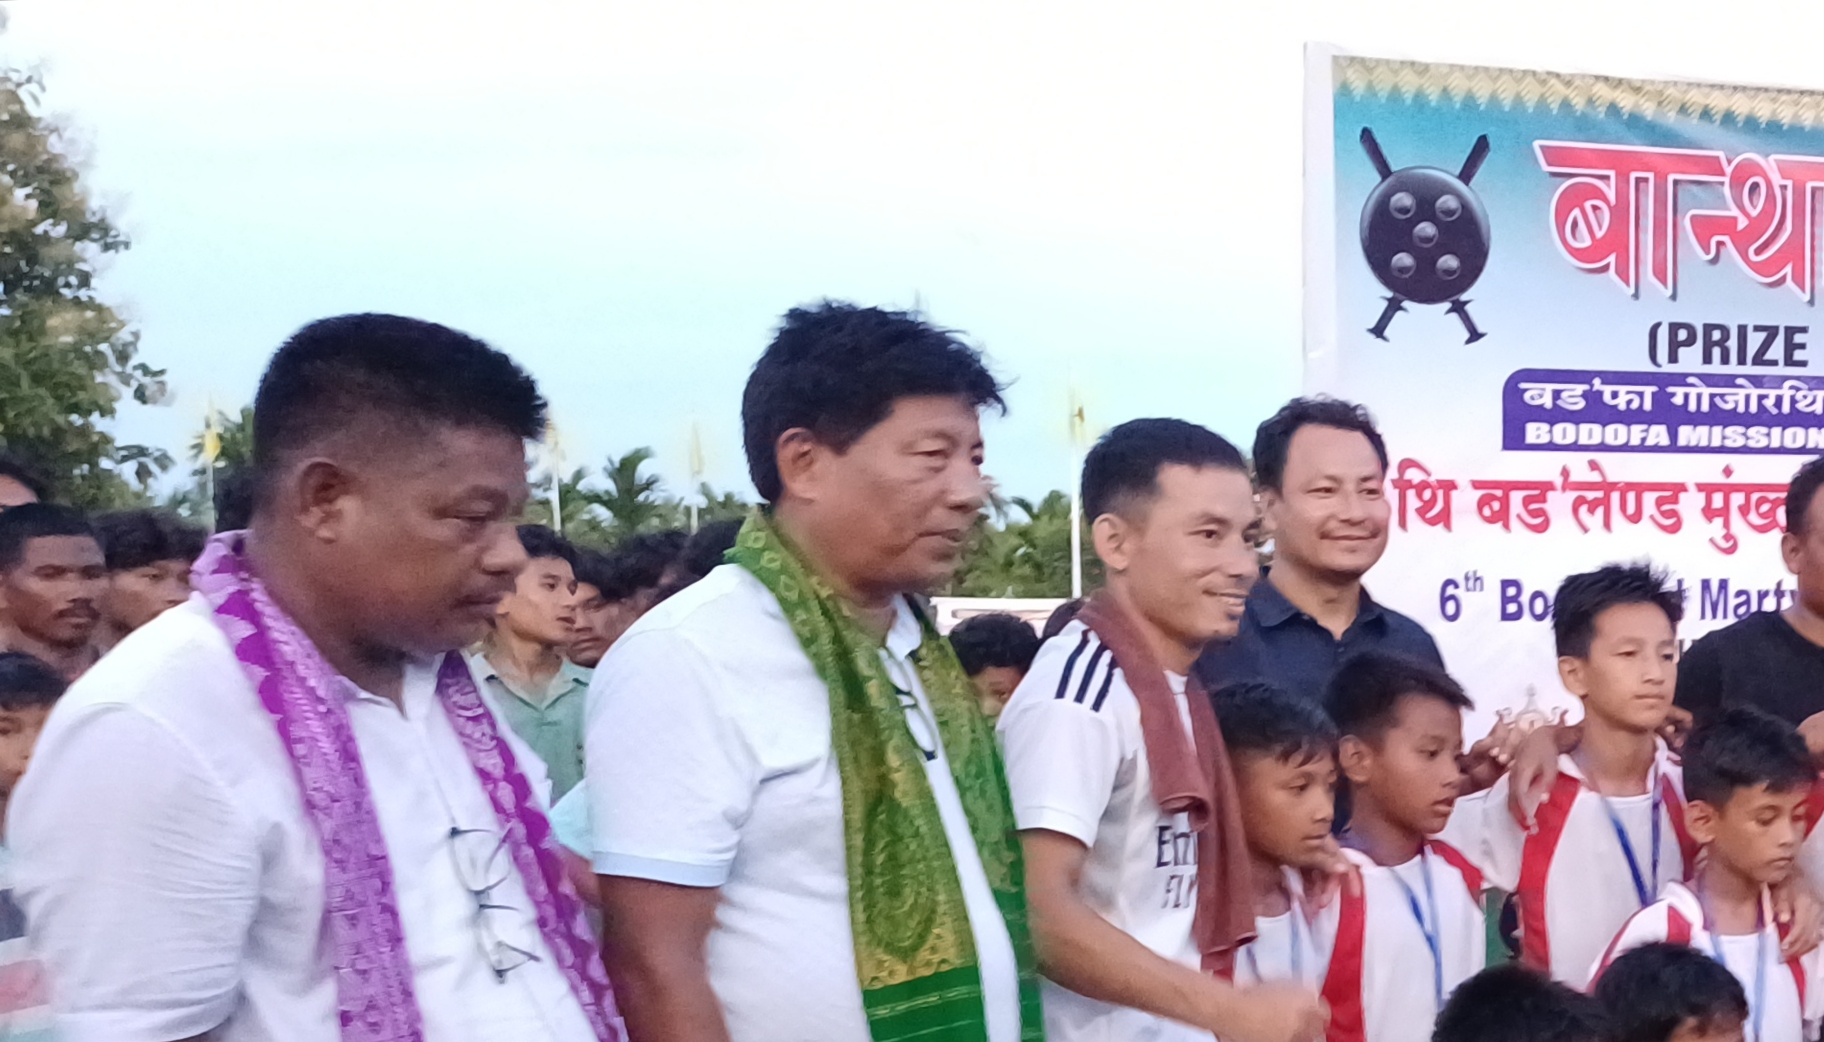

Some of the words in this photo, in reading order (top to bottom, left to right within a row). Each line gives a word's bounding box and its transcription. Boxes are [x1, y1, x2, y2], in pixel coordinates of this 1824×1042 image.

[1649, 321, 1809, 368] (PRIZE
[1525, 422, 1671, 446] BODOFA
[1439, 570, 1485, 623] 6th
[1699, 578, 1798, 622] Mart
